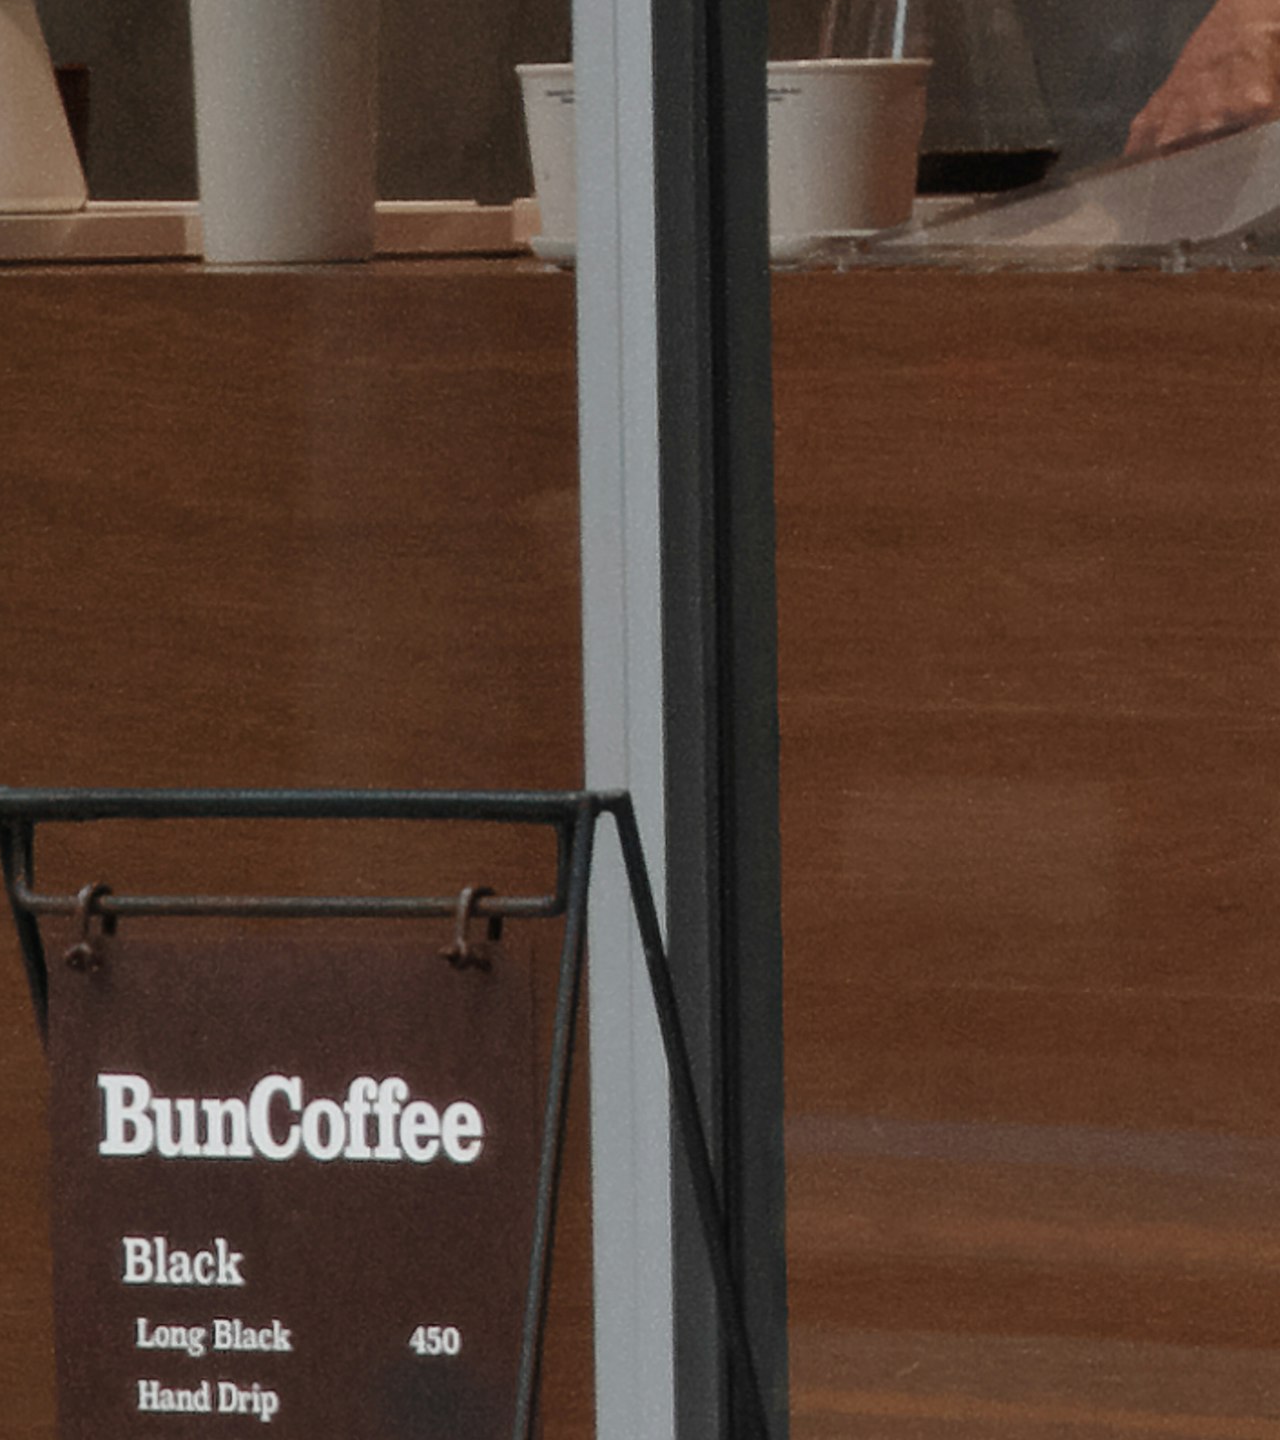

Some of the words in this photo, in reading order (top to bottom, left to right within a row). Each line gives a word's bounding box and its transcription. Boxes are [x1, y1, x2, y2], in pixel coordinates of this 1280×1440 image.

[97, 1073, 483, 1163] BunCoffee
[122, 1236, 245, 1286] Black
[136, 1317, 207, 1357] Long
[212, 1318, 292, 1352] Black
[409, 1326, 461, 1356] 450
[137, 1379, 212, 1413] Hand
[217, 1381, 280, 1423] Drip
